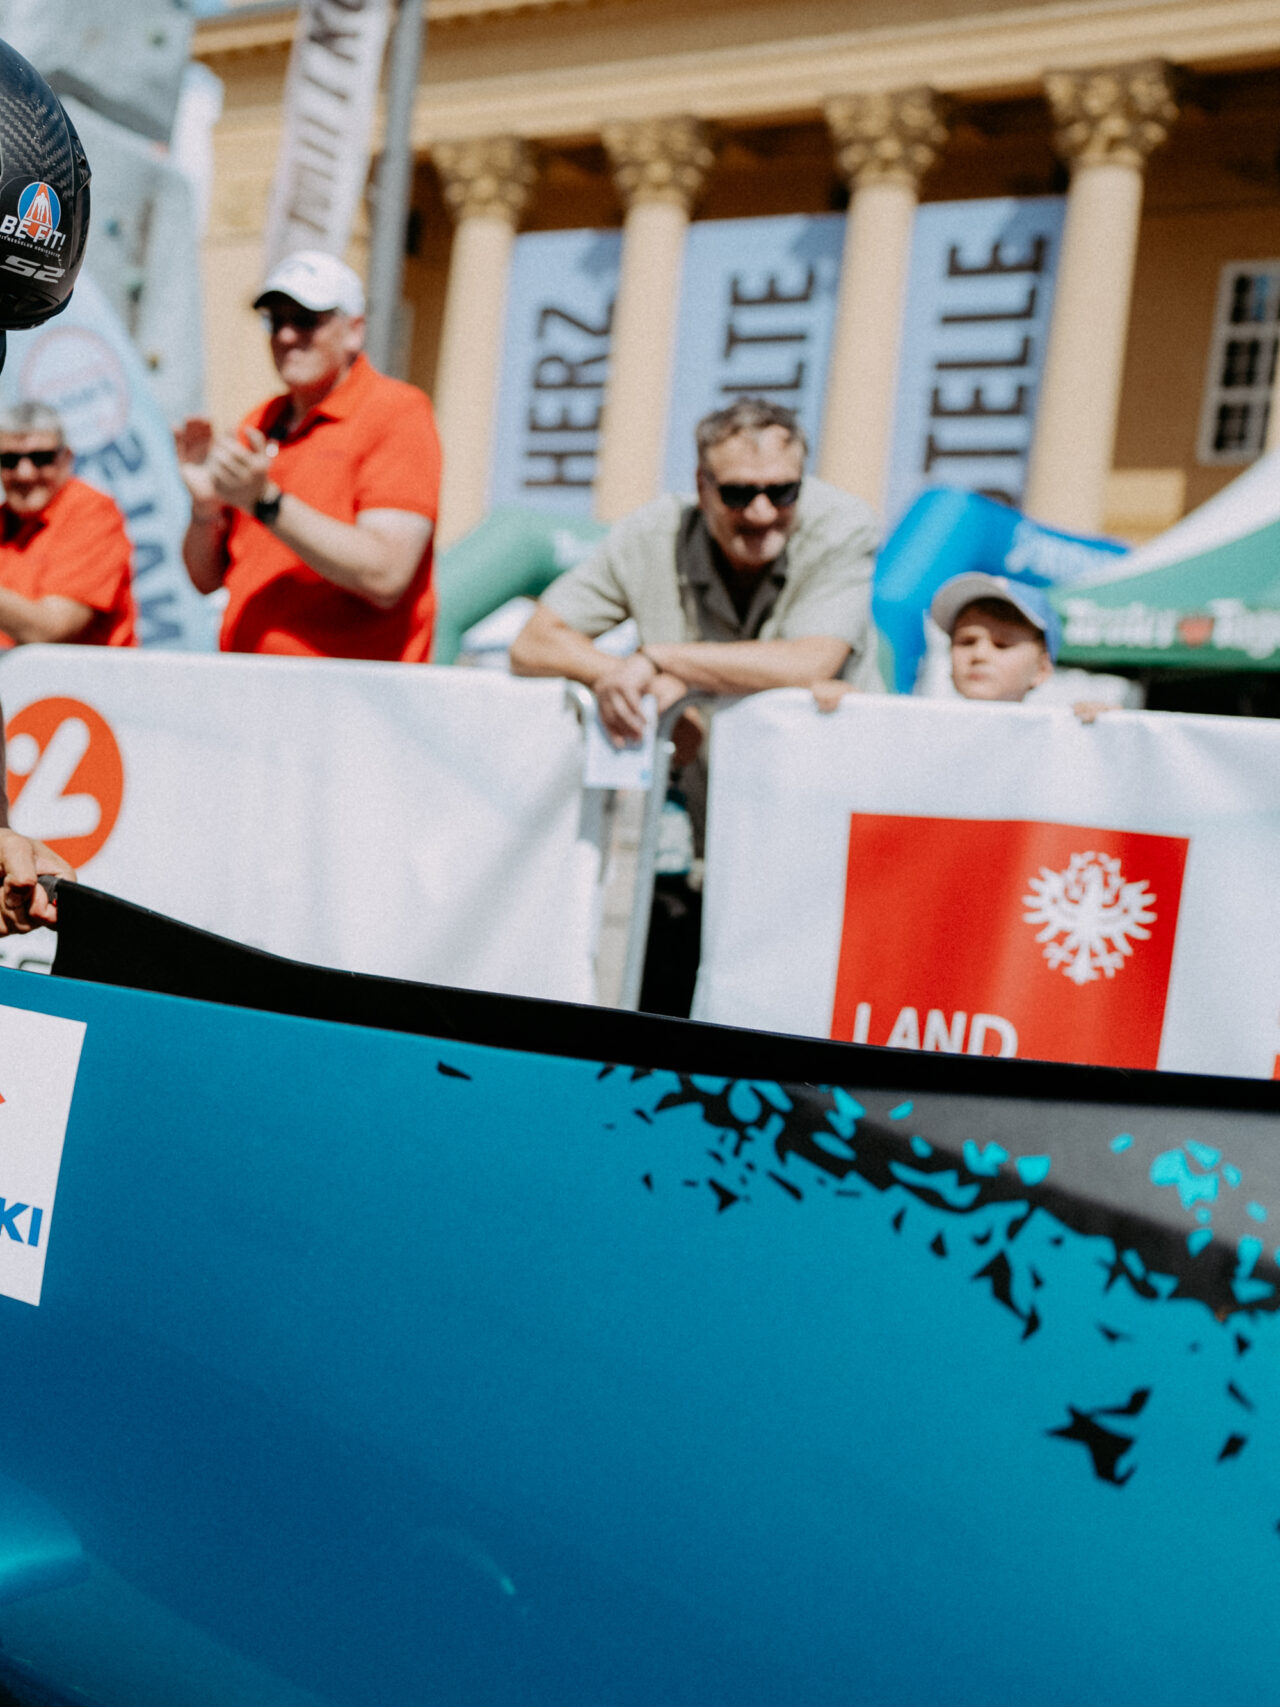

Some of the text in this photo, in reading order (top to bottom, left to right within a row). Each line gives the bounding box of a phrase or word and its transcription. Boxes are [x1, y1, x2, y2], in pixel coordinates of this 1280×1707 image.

[0, 214, 32, 239] BE
[33, 225, 66, 252] FIT!
[523, 299, 616, 488] HERZ
[720, 265, 814, 414] LTE
[923, 235, 1048, 505] TELLE
[852, 1002, 1018, 1058] LAND
